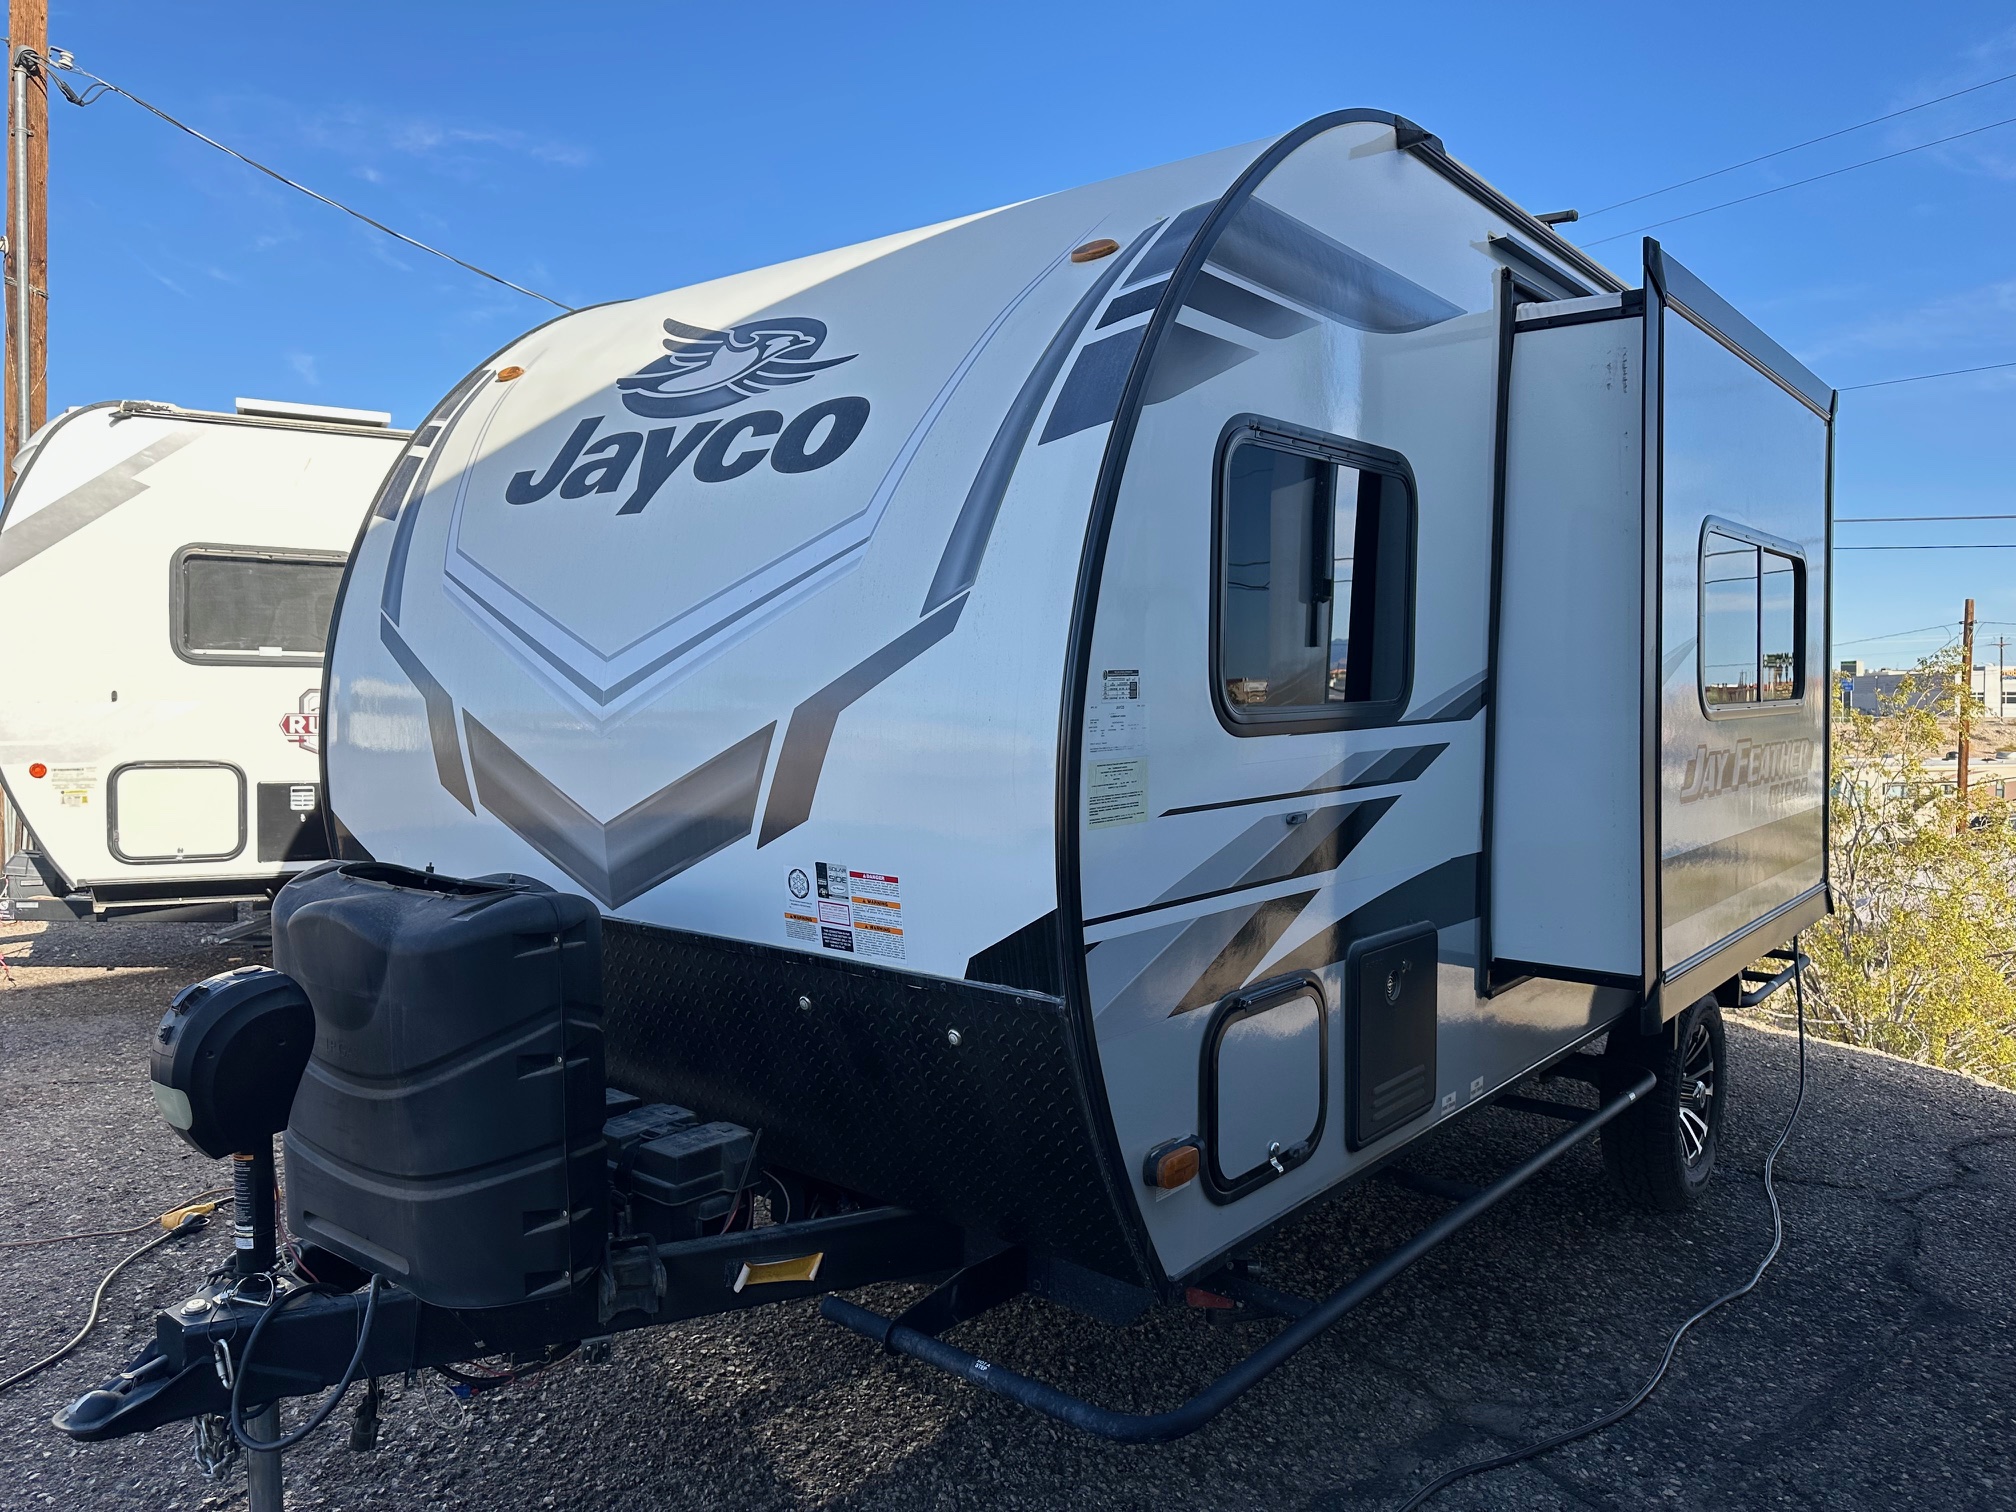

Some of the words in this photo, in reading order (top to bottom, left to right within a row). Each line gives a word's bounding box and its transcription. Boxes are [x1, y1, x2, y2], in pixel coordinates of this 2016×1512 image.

[505, 396, 870, 515] Jayco
[1680, 744, 1730, 806] JAY
[1732, 738, 1814, 791] FEATHER
[1768, 777, 1808, 806] MICRO
[866, 873, 885, 881] DANGER
[867, 899, 888, 907] WARNING
[870, 925, 891, 933] WARNING
[974, 1363, 988, 1371] STEP
